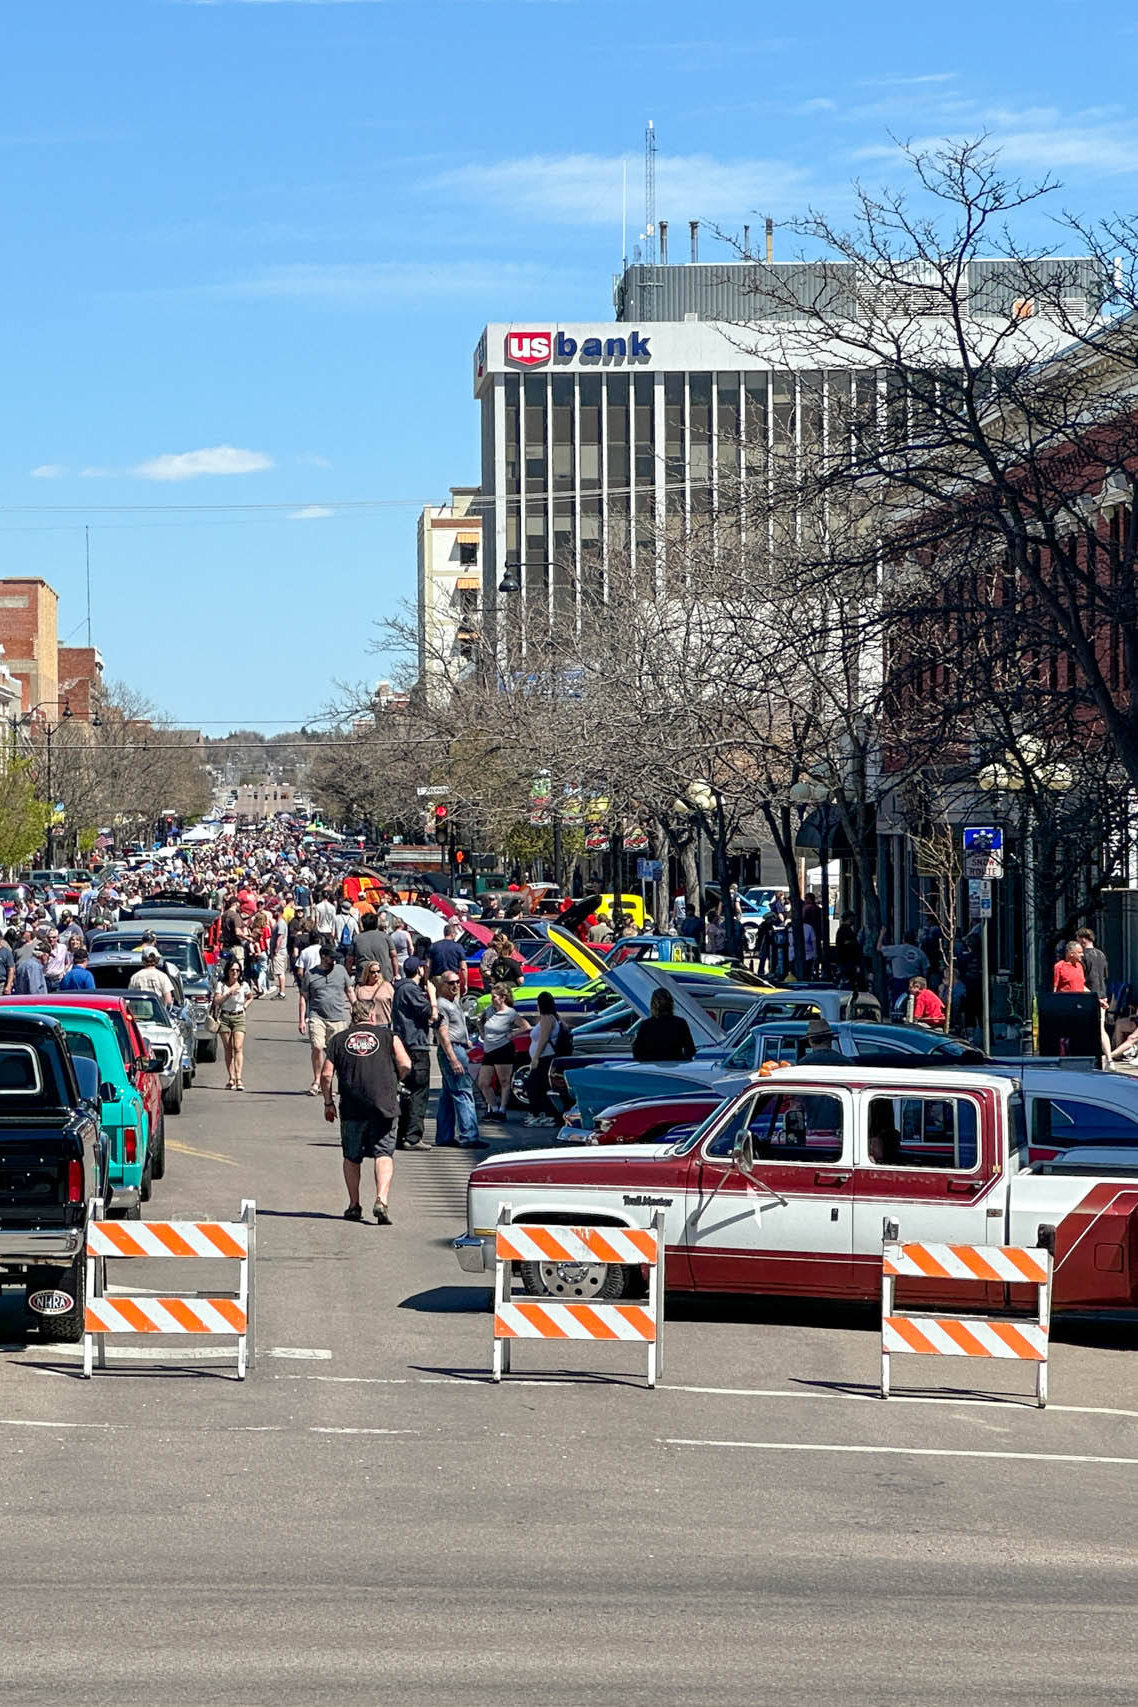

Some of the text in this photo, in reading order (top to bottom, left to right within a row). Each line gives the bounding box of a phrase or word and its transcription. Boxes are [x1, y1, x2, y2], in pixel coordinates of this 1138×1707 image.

[512, 337, 550, 358] us
[557, 331, 652, 357] bank
[37, 1296, 66, 1308] NHRA
